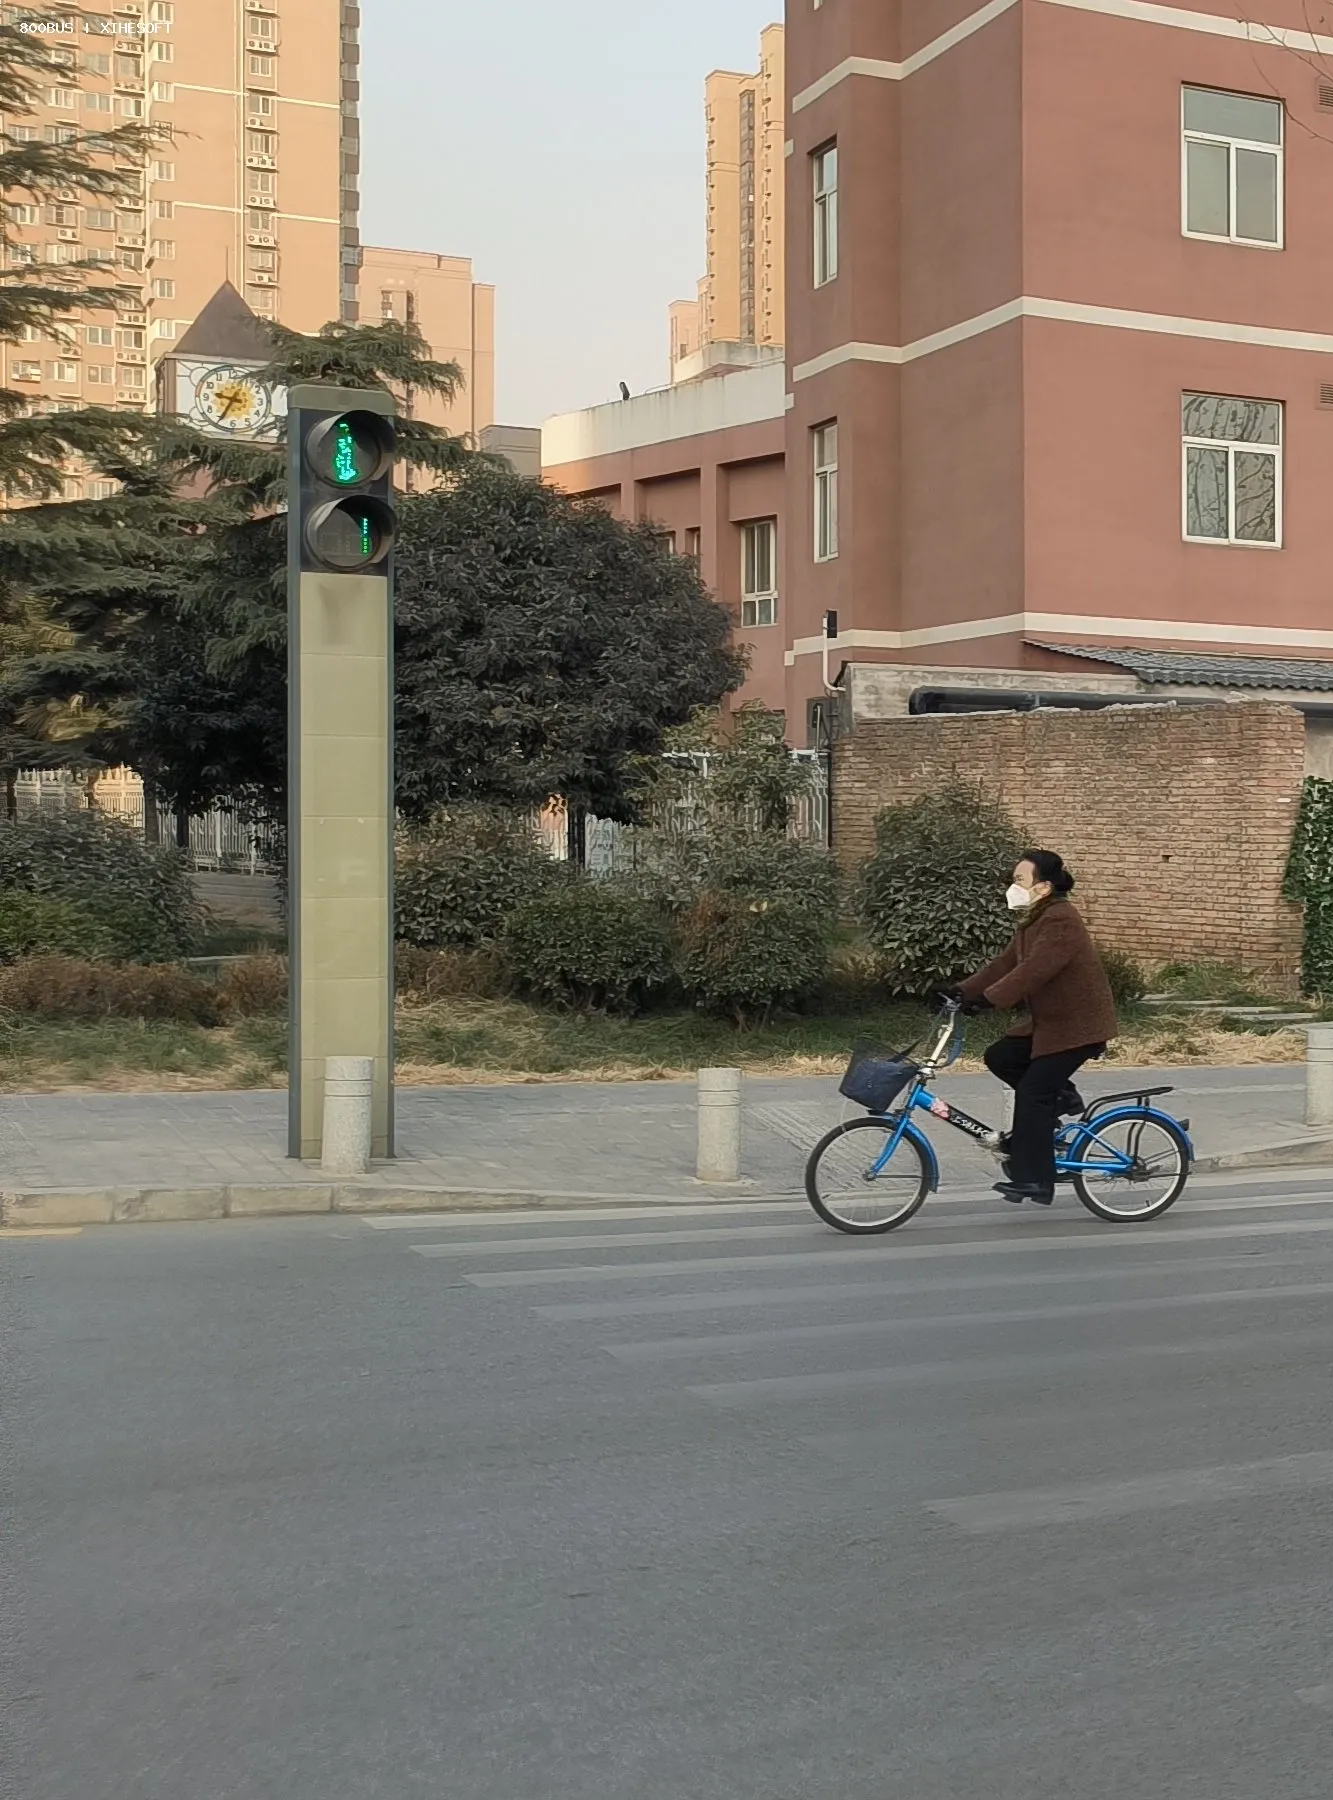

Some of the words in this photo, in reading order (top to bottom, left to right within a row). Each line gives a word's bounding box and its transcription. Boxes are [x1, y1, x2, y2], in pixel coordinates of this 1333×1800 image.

[254, 385, 261, 394] 2
[203, 393, 210, 401] 9
[257, 398, 264, 406] 3
[229, 420, 237, 428] 6
[244, 418, 252, 427] 5
